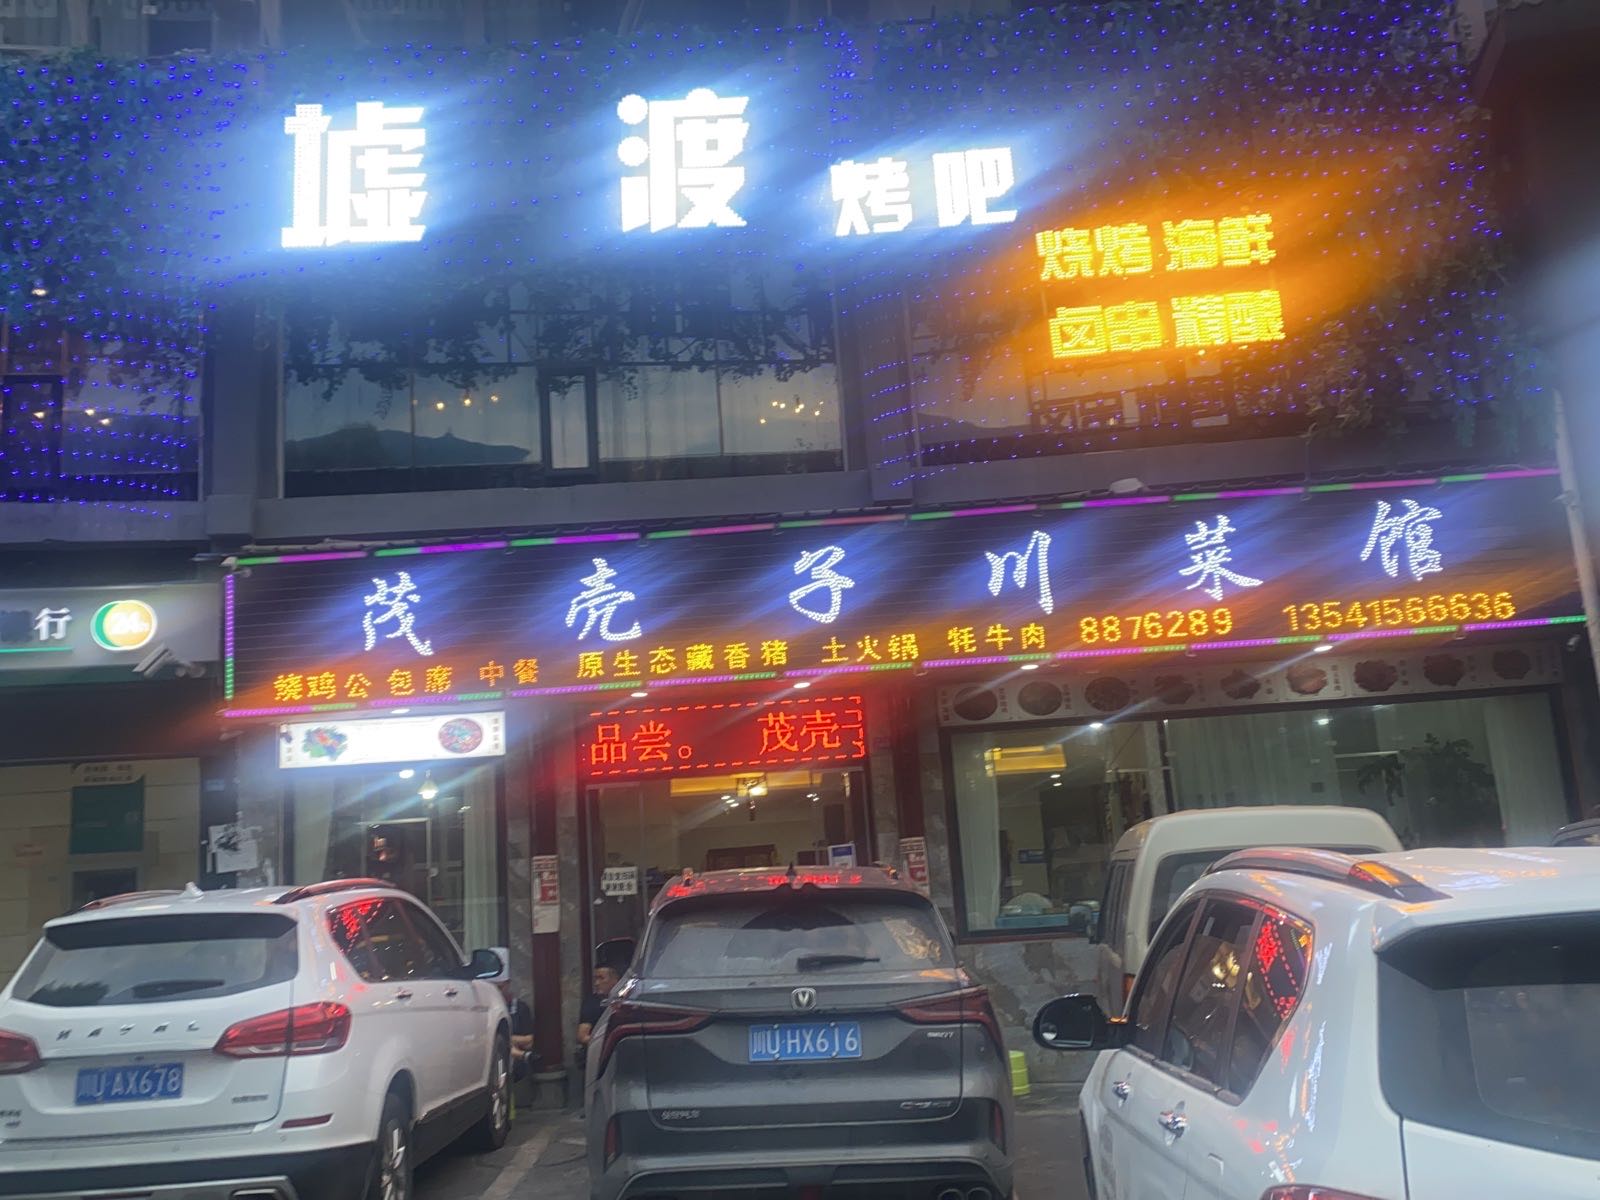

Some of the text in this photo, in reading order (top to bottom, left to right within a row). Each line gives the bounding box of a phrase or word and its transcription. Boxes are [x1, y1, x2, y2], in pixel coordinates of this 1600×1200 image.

[829, 147, 1018, 237] 烤吧
[1036, 213, 1276, 281] 烧烤 海鲜
[364, 498, 1443, 656] 茂壳子川菜馆
[479, 658, 539, 687] 中餐
[577, 627, 788, 678] 原生态藏香猪
[821, 634, 919, 663] 土火锅
[948, 623, 1046, 654] 牦牛肉
[1079, 608, 1233, 645] 8876289
[1282, 592, 1516, 632] 13541566636
